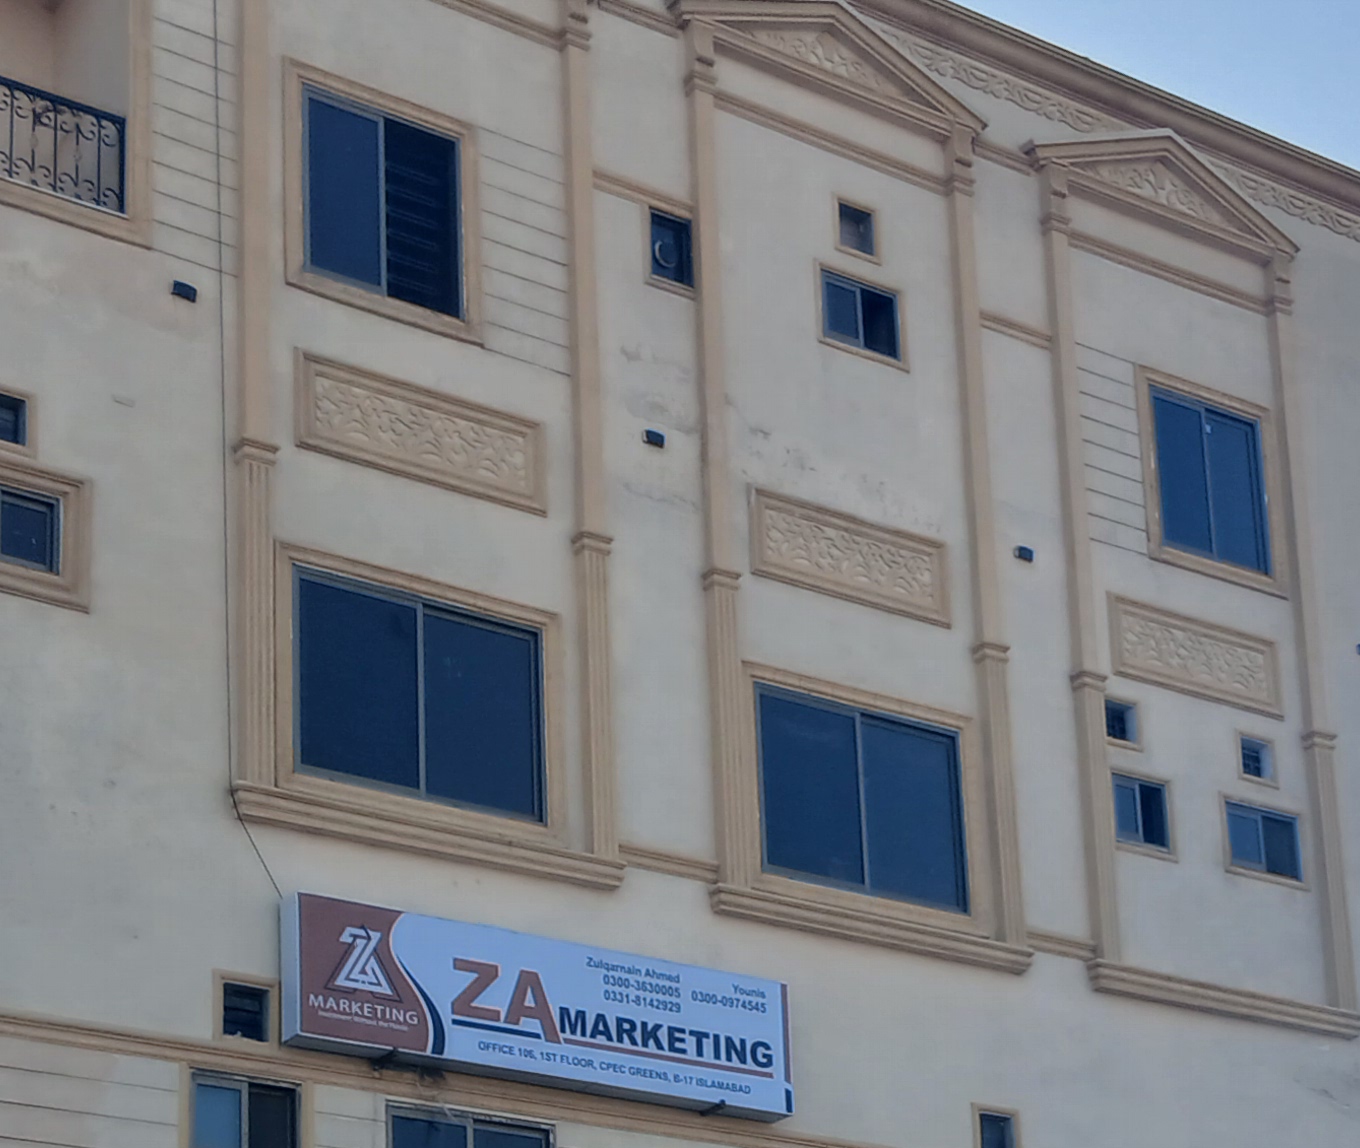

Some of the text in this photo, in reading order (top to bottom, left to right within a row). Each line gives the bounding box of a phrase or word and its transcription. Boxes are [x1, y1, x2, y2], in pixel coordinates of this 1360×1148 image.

[644, 967, 681, 984] Ahmed
[732, 983, 766, 1000] Younis
[308, 993, 420, 1025] MARKETING
[451, 957, 563, 1044] ZA
[559, 1006, 774, 1069] MARKETING
[478, 1040, 515, 1056] OFFICE
[540, 1050, 558, 1063] 1ST
[599, 1061, 626, 1075] CPEC
[628, 1066, 671, 1083] GREENS,
[695, 1076, 752, 1095] ISLAMABAD
